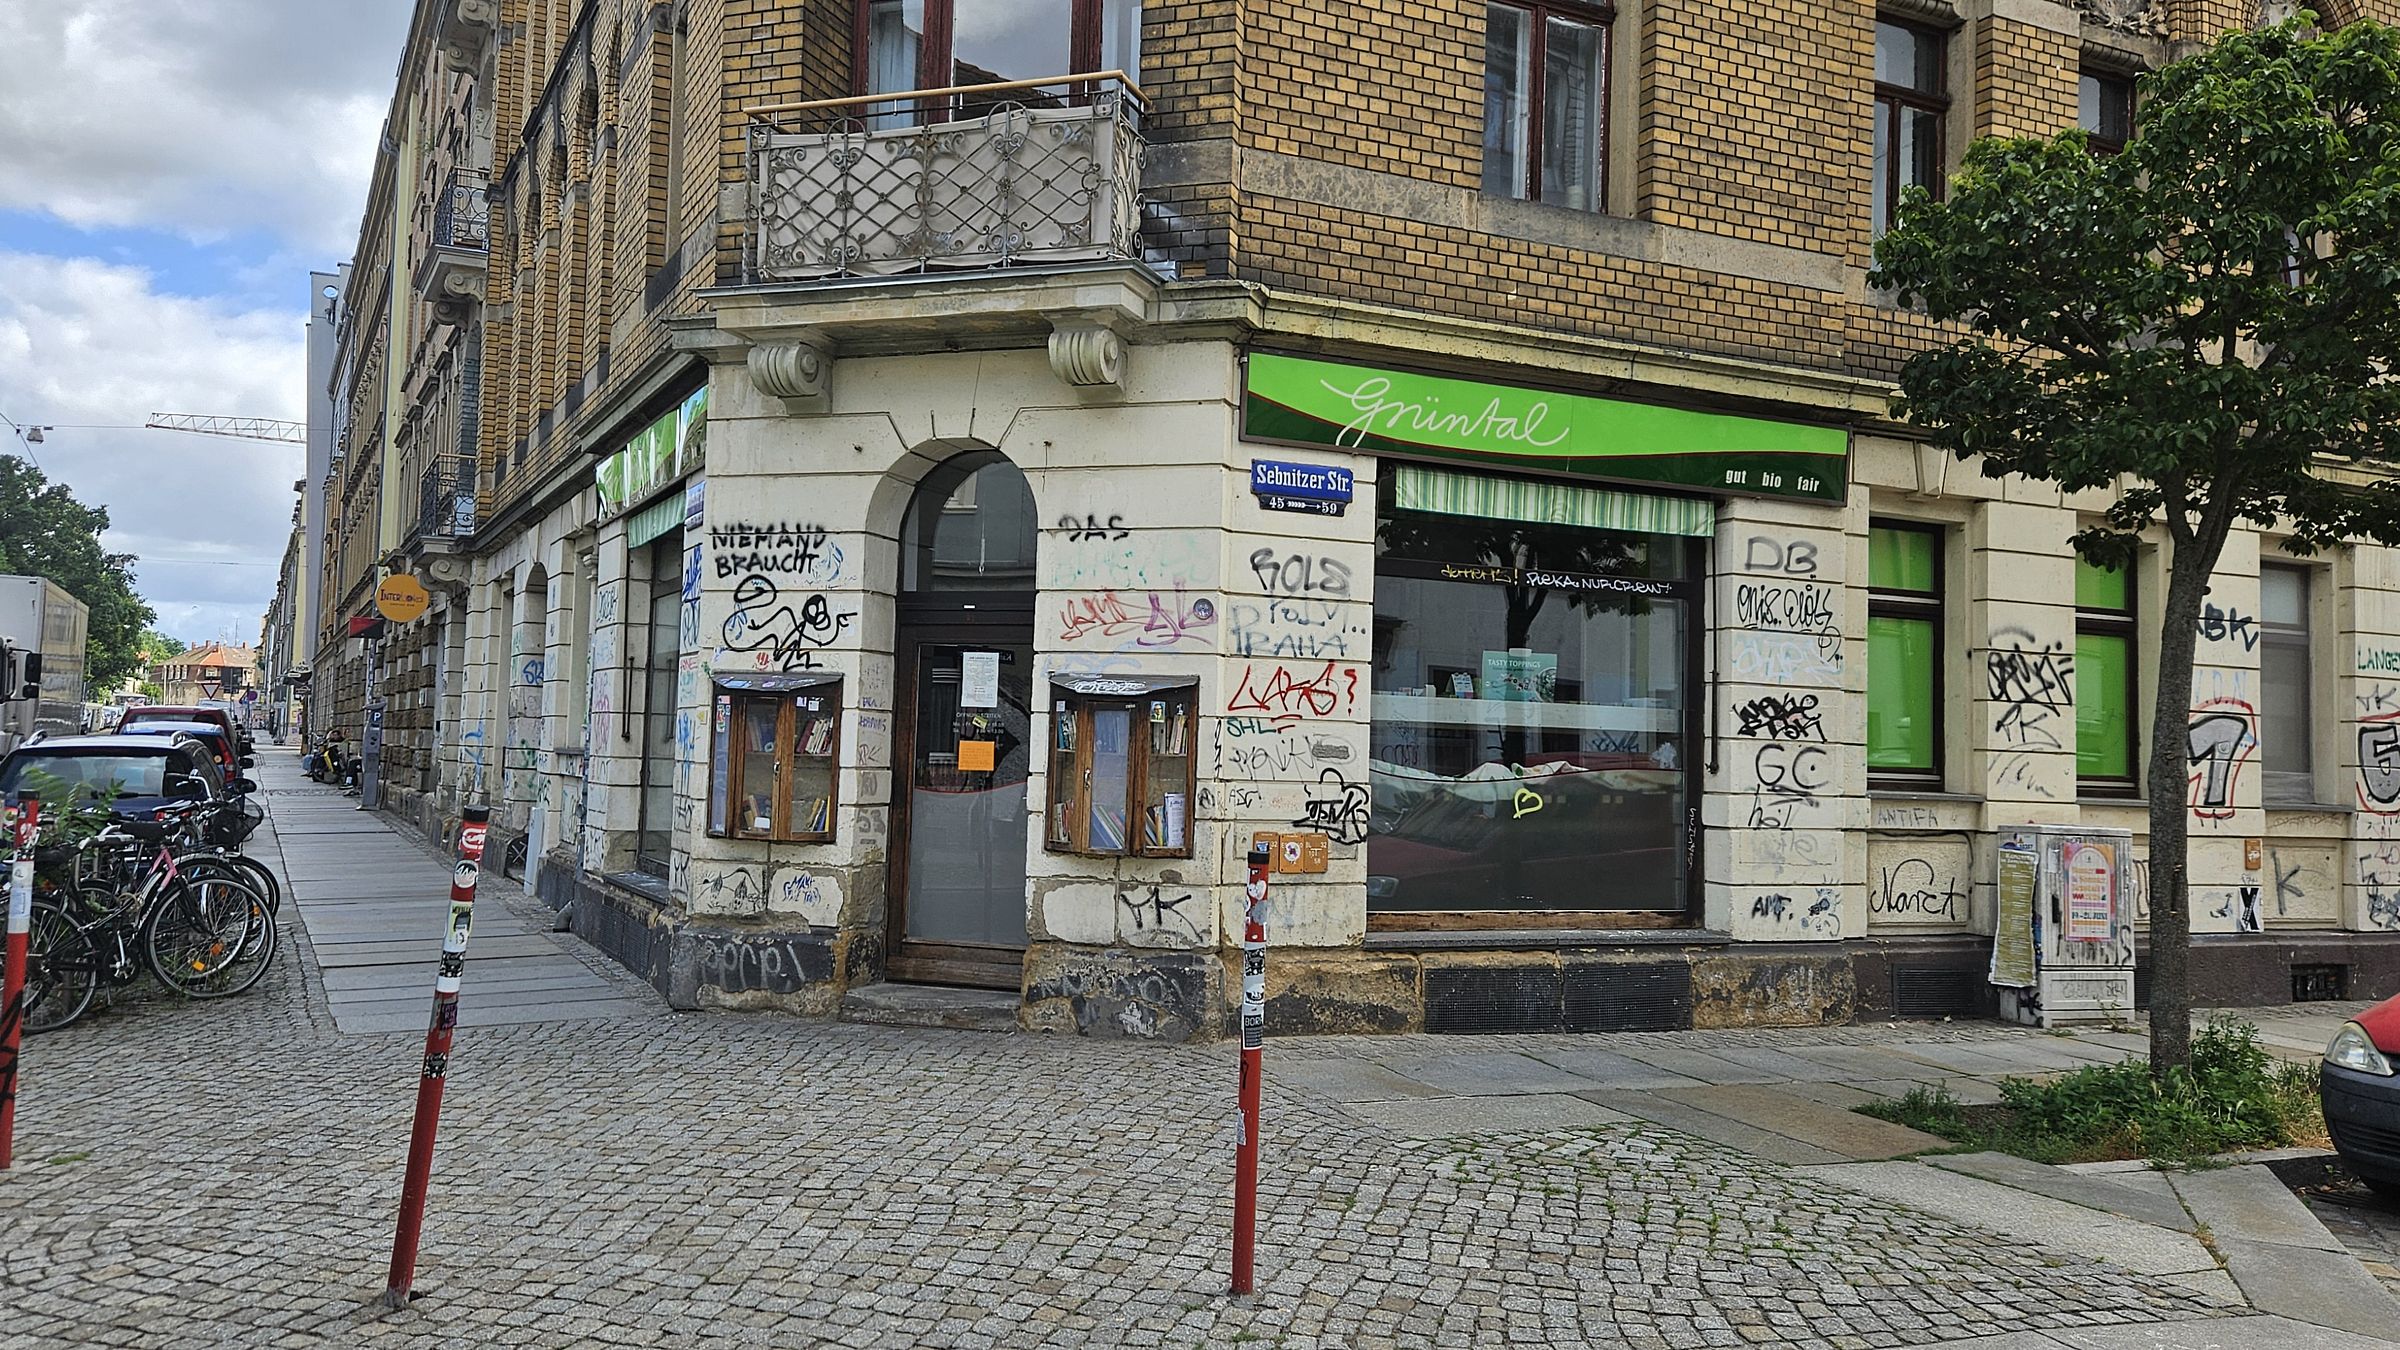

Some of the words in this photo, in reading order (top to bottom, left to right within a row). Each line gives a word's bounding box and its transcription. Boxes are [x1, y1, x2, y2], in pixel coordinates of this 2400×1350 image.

[1320, 377, 1570, 448] Grüntal
[1256, 464, 1326, 490] Sebnitzer
[1327, 470, 1350, 492] Str.
[1725, 469, 1747, 485] gut
[1761, 471, 1782, 489] bio
[1796, 476, 1821, 493] fair
[1269, 496, 1285, 509] 45
[1321, 502, 1337, 514] 59
[711, 521, 827, 550] NIEMAND
[1058, 514, 1130, 542] DAS
[714, 548, 821, 579] BRAUCHT
[1488, 659, 1507, 668] TASTY
[374, 712, 381, 722] P
[1877, 802, 1939, 827] ANTIFA
